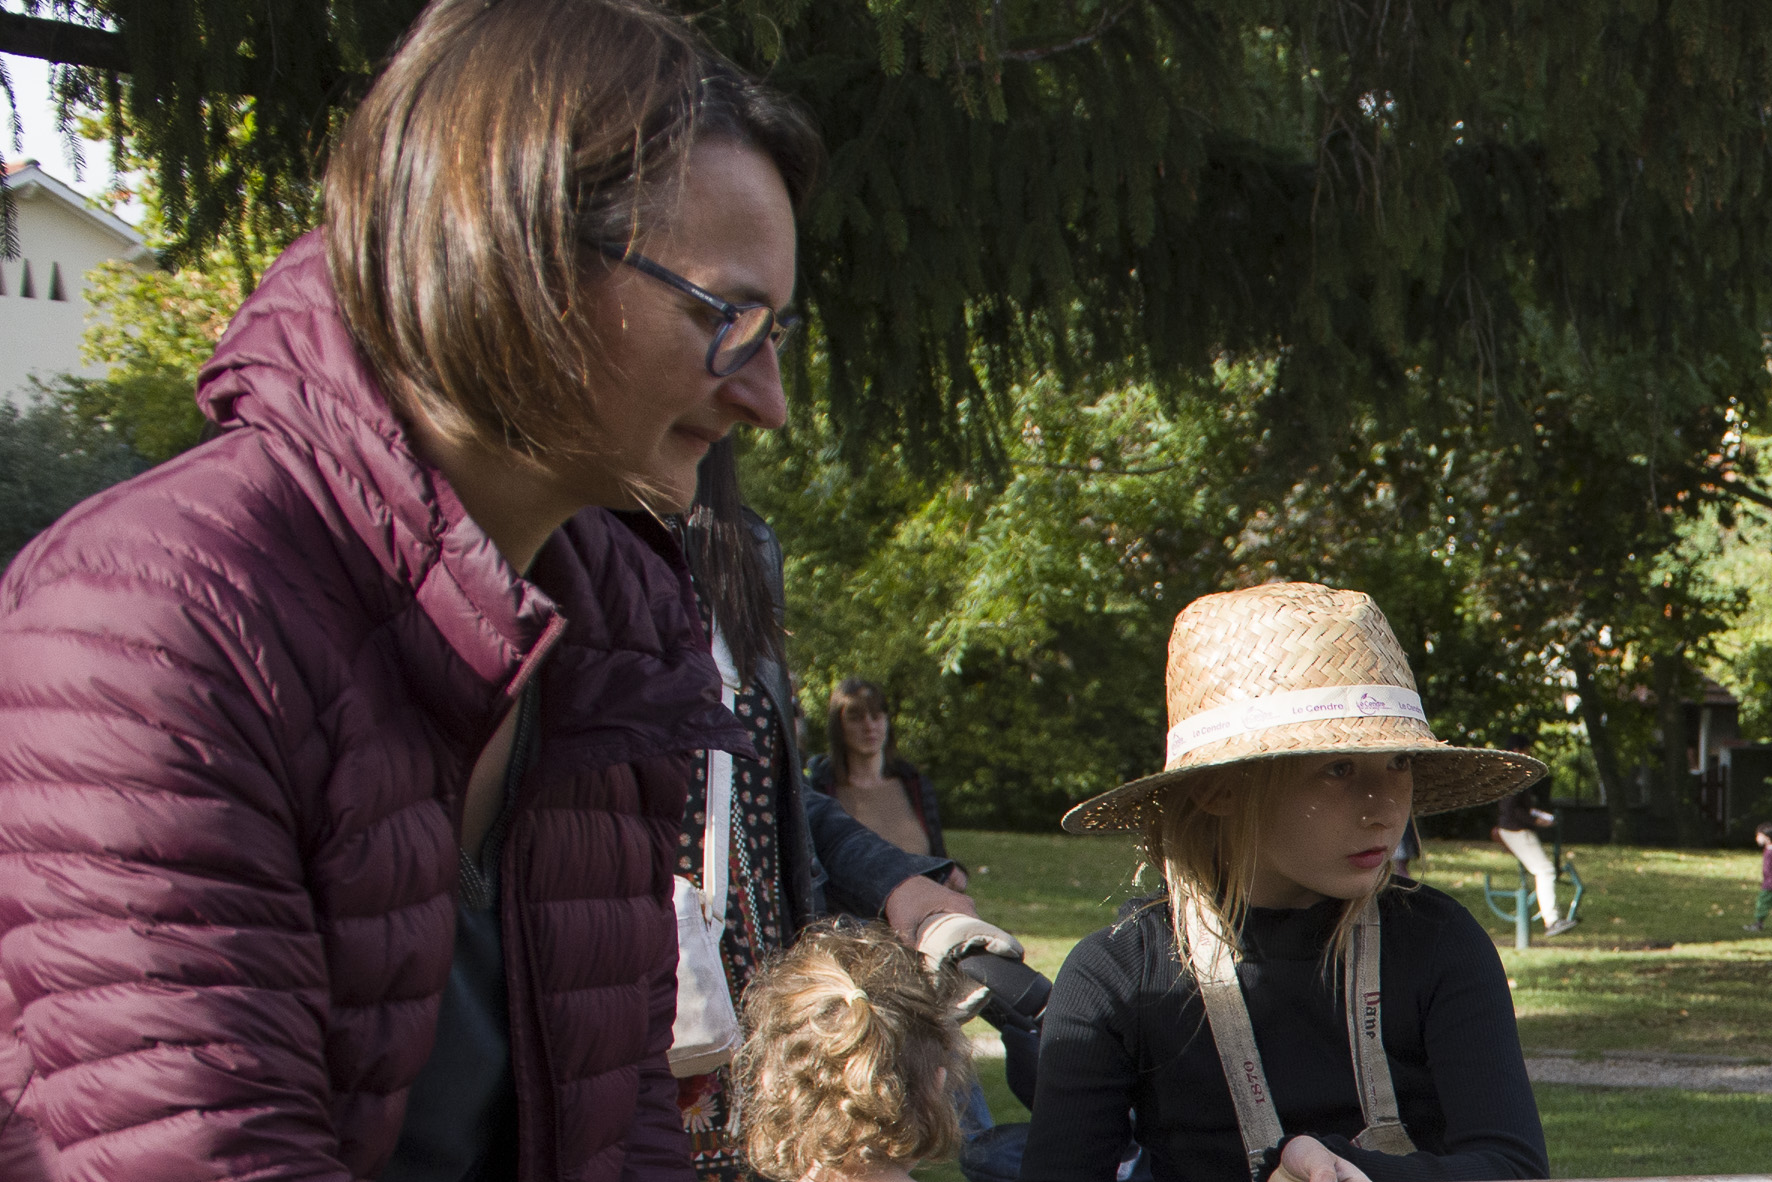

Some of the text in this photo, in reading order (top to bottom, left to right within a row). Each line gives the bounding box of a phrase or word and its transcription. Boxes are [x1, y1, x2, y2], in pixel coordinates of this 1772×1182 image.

[1201, 721, 1231, 735] Cendre
[1292, 704, 1304, 715] Le
[1306, 702, 1344, 713] Cendre
[1243, 1060, 1266, 1104] 1870
